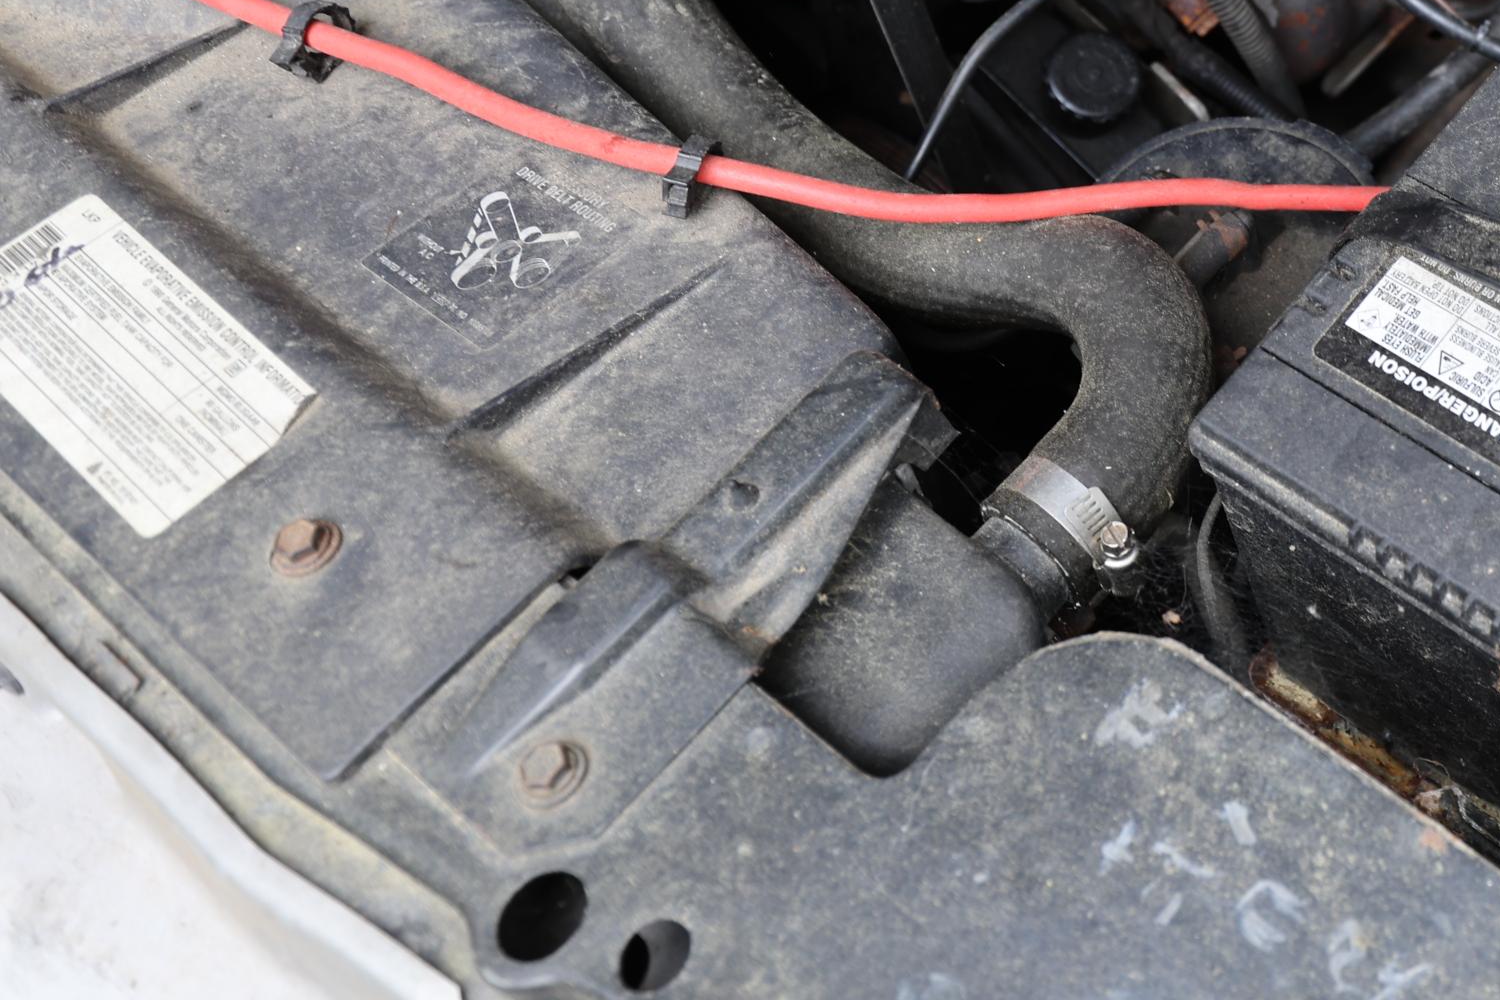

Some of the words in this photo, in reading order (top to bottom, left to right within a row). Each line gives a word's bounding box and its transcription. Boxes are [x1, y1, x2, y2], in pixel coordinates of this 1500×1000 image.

[515, 165, 552, 190] DRIVE
[543, 184, 575, 206] BELT
[568, 200, 617, 232] ROUTING
[1378, 278, 1403, 296] FAST.
[1389, 268, 1422, 289] BATTERY
[1370, 287, 1408, 311] MEDICAL
[1398, 290, 1421, 307] HELP
[1416, 283, 1440, 300] OPEN
[1442, 286, 1461, 300] NOT
[1479, 286, 1497, 299] OR
[1434, 294, 1454, 308] NOT
[1449, 303, 1464, 314] DO
[1456, 295, 1471, 306] DO
[110, 229, 147, 260] VEHICLE
[138, 253, 192, 301] EVAPORATIVE
[183, 295, 227, 333] EMISSION
[218, 326, 261, 364] CONTROL
[252, 357, 311, 409] INFORMATIO
[1402, 305, 1422, 320] GET
[1482, 321, 1499, 333] ALL
[1379, 332, 1403, 349] EYES
[1381, 320, 1433, 353] IMMEDIATELY
[1416, 327, 1440, 345] WITH
[1398, 344, 1425, 363] FLUSH
[1447, 333, 1485, 357] BLINDNESS
[1471, 370, 1493, 387] ACID
[1483, 364, 1500, 378] CAN
[1446, 370, 1486, 398] SULFURIC
